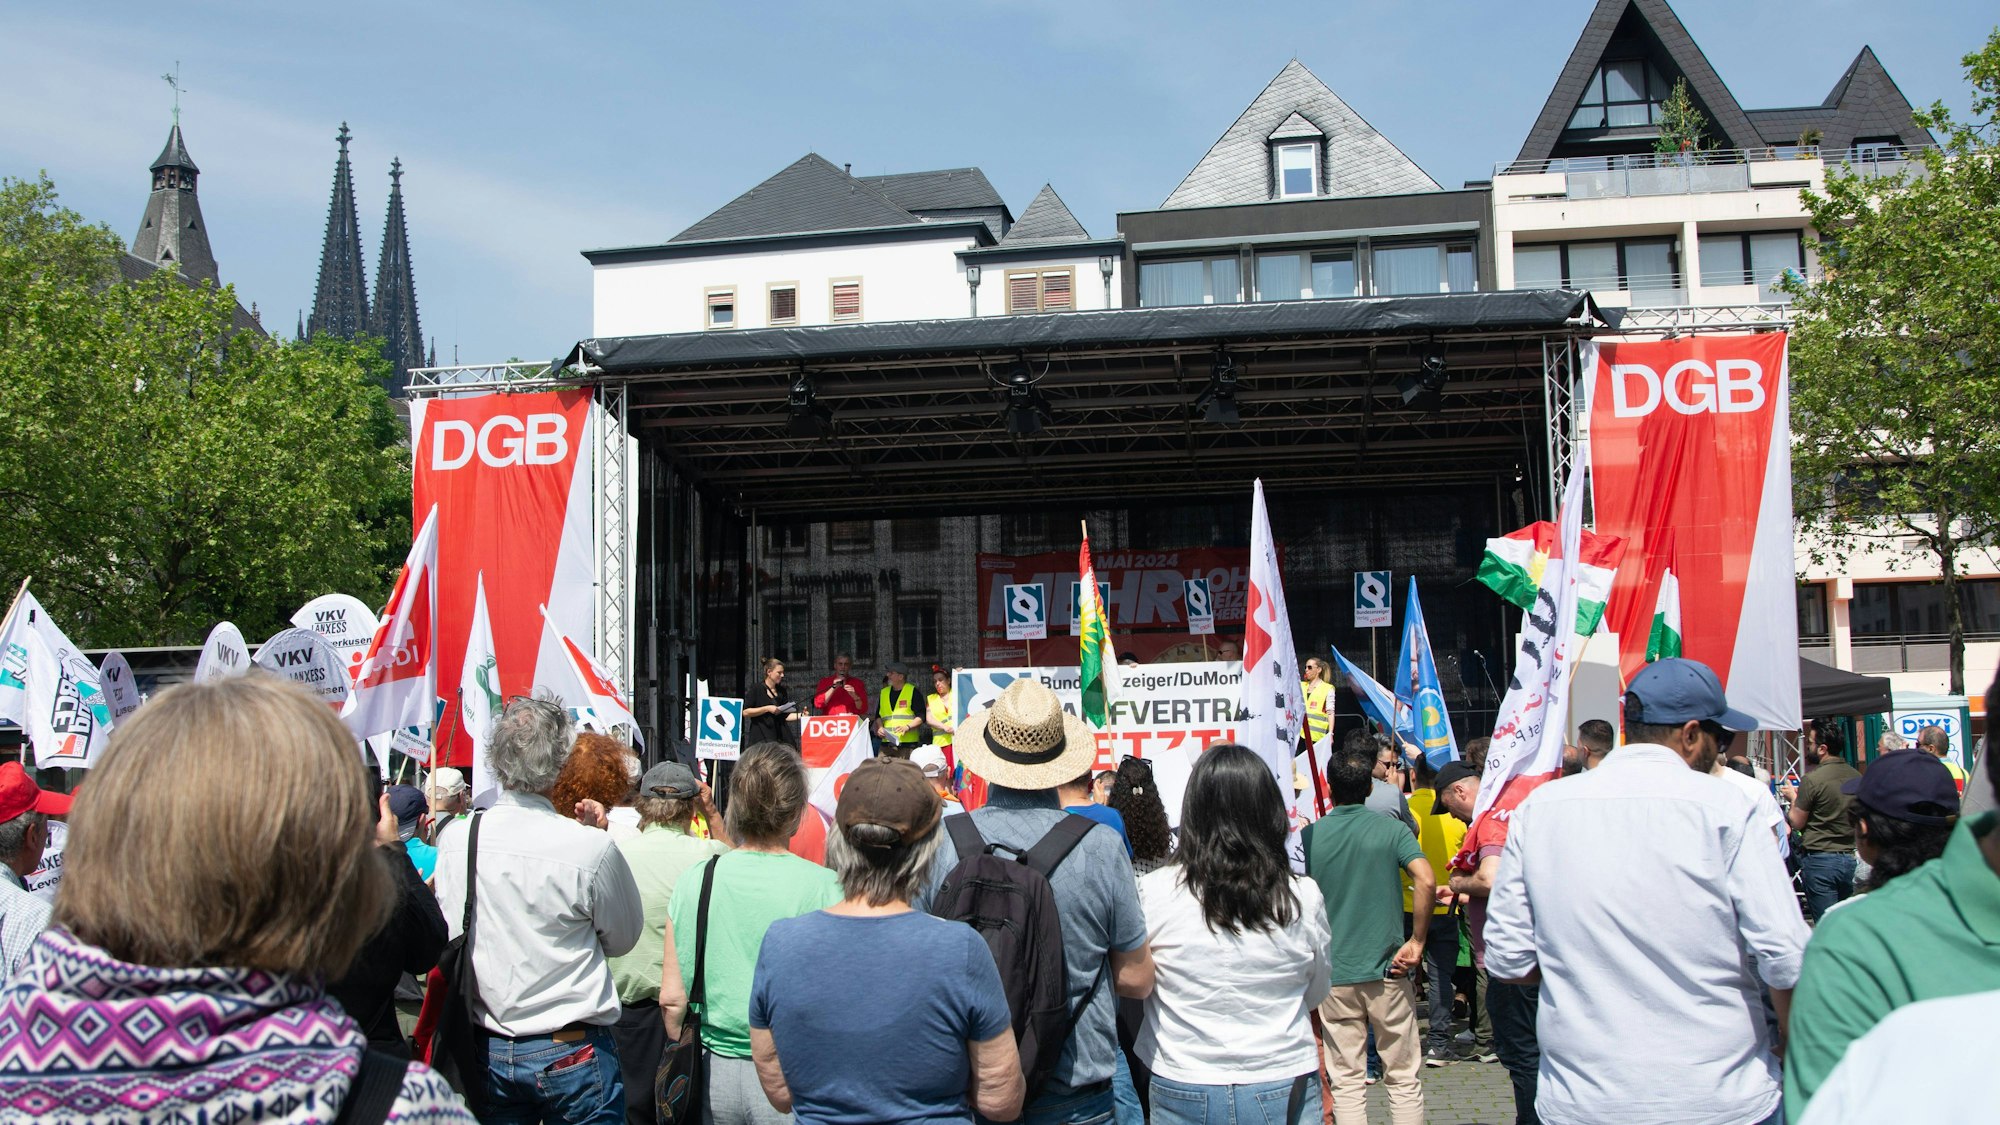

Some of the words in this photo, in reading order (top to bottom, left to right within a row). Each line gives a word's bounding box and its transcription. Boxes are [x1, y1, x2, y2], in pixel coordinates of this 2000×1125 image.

[1610, 358, 1766, 418] DGB
[432, 413, 569, 471] DGB
[1097, 554, 1131, 568] MAI
[1135, 553, 1178, 568] 2024
[315, 608, 346, 622] VKV
[312, 621, 347, 634] LANXESS
[332, 637, 372, 647] erkusen
[217, 642, 239, 667] VKV
[274, 648, 313, 667] VKV
[809, 719, 850, 738] DGB
[698, 741, 738, 749] Bundesanzeiger
